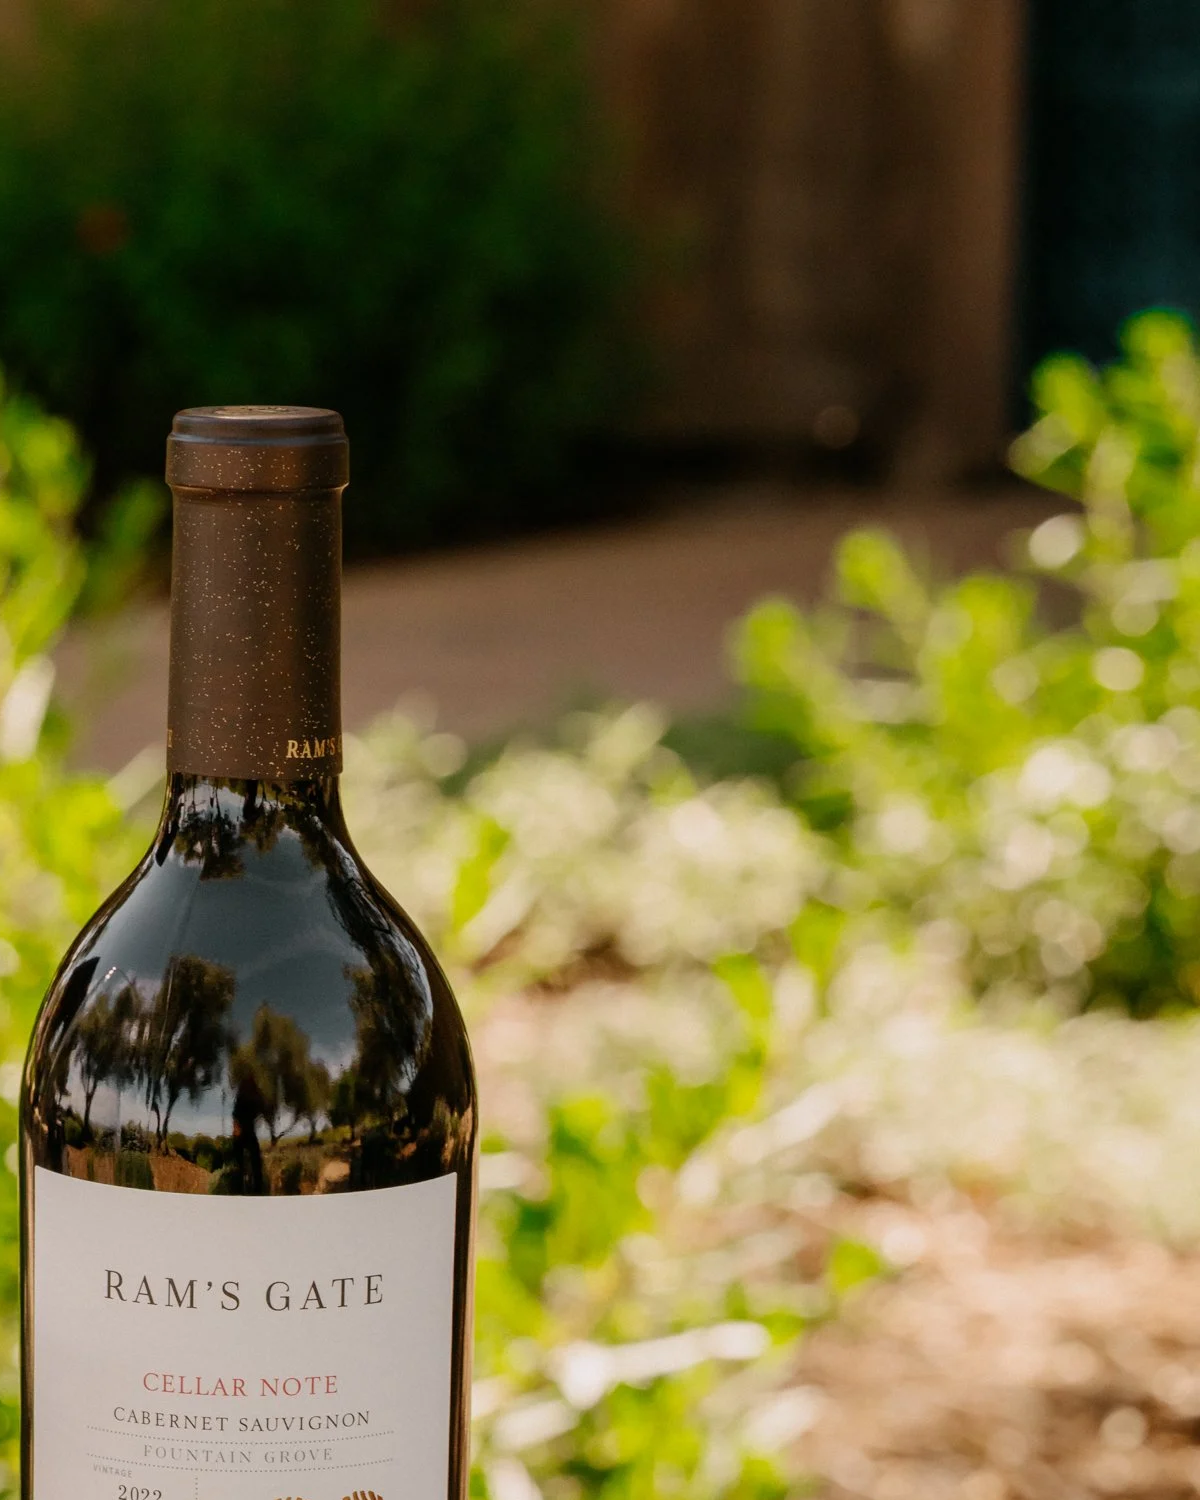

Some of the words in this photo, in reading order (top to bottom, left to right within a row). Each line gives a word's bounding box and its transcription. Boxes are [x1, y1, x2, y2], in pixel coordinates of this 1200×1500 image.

[104, 1269, 241, 1312] RAM'S
[265, 1274, 384, 1312] GATE
[143, 1372, 247, 1397] CELLAR
[260, 1375, 339, 1397] NOTE
[113, 1407, 229, 1432] CABERNET
[239, 1411, 371, 1432] SAUVIGNON
[143, 1444, 253, 1464] FOUNTAIN
[264, 1448, 335, 1464] GROVE
[93, 1464, 132, 1478] VINTAGE
